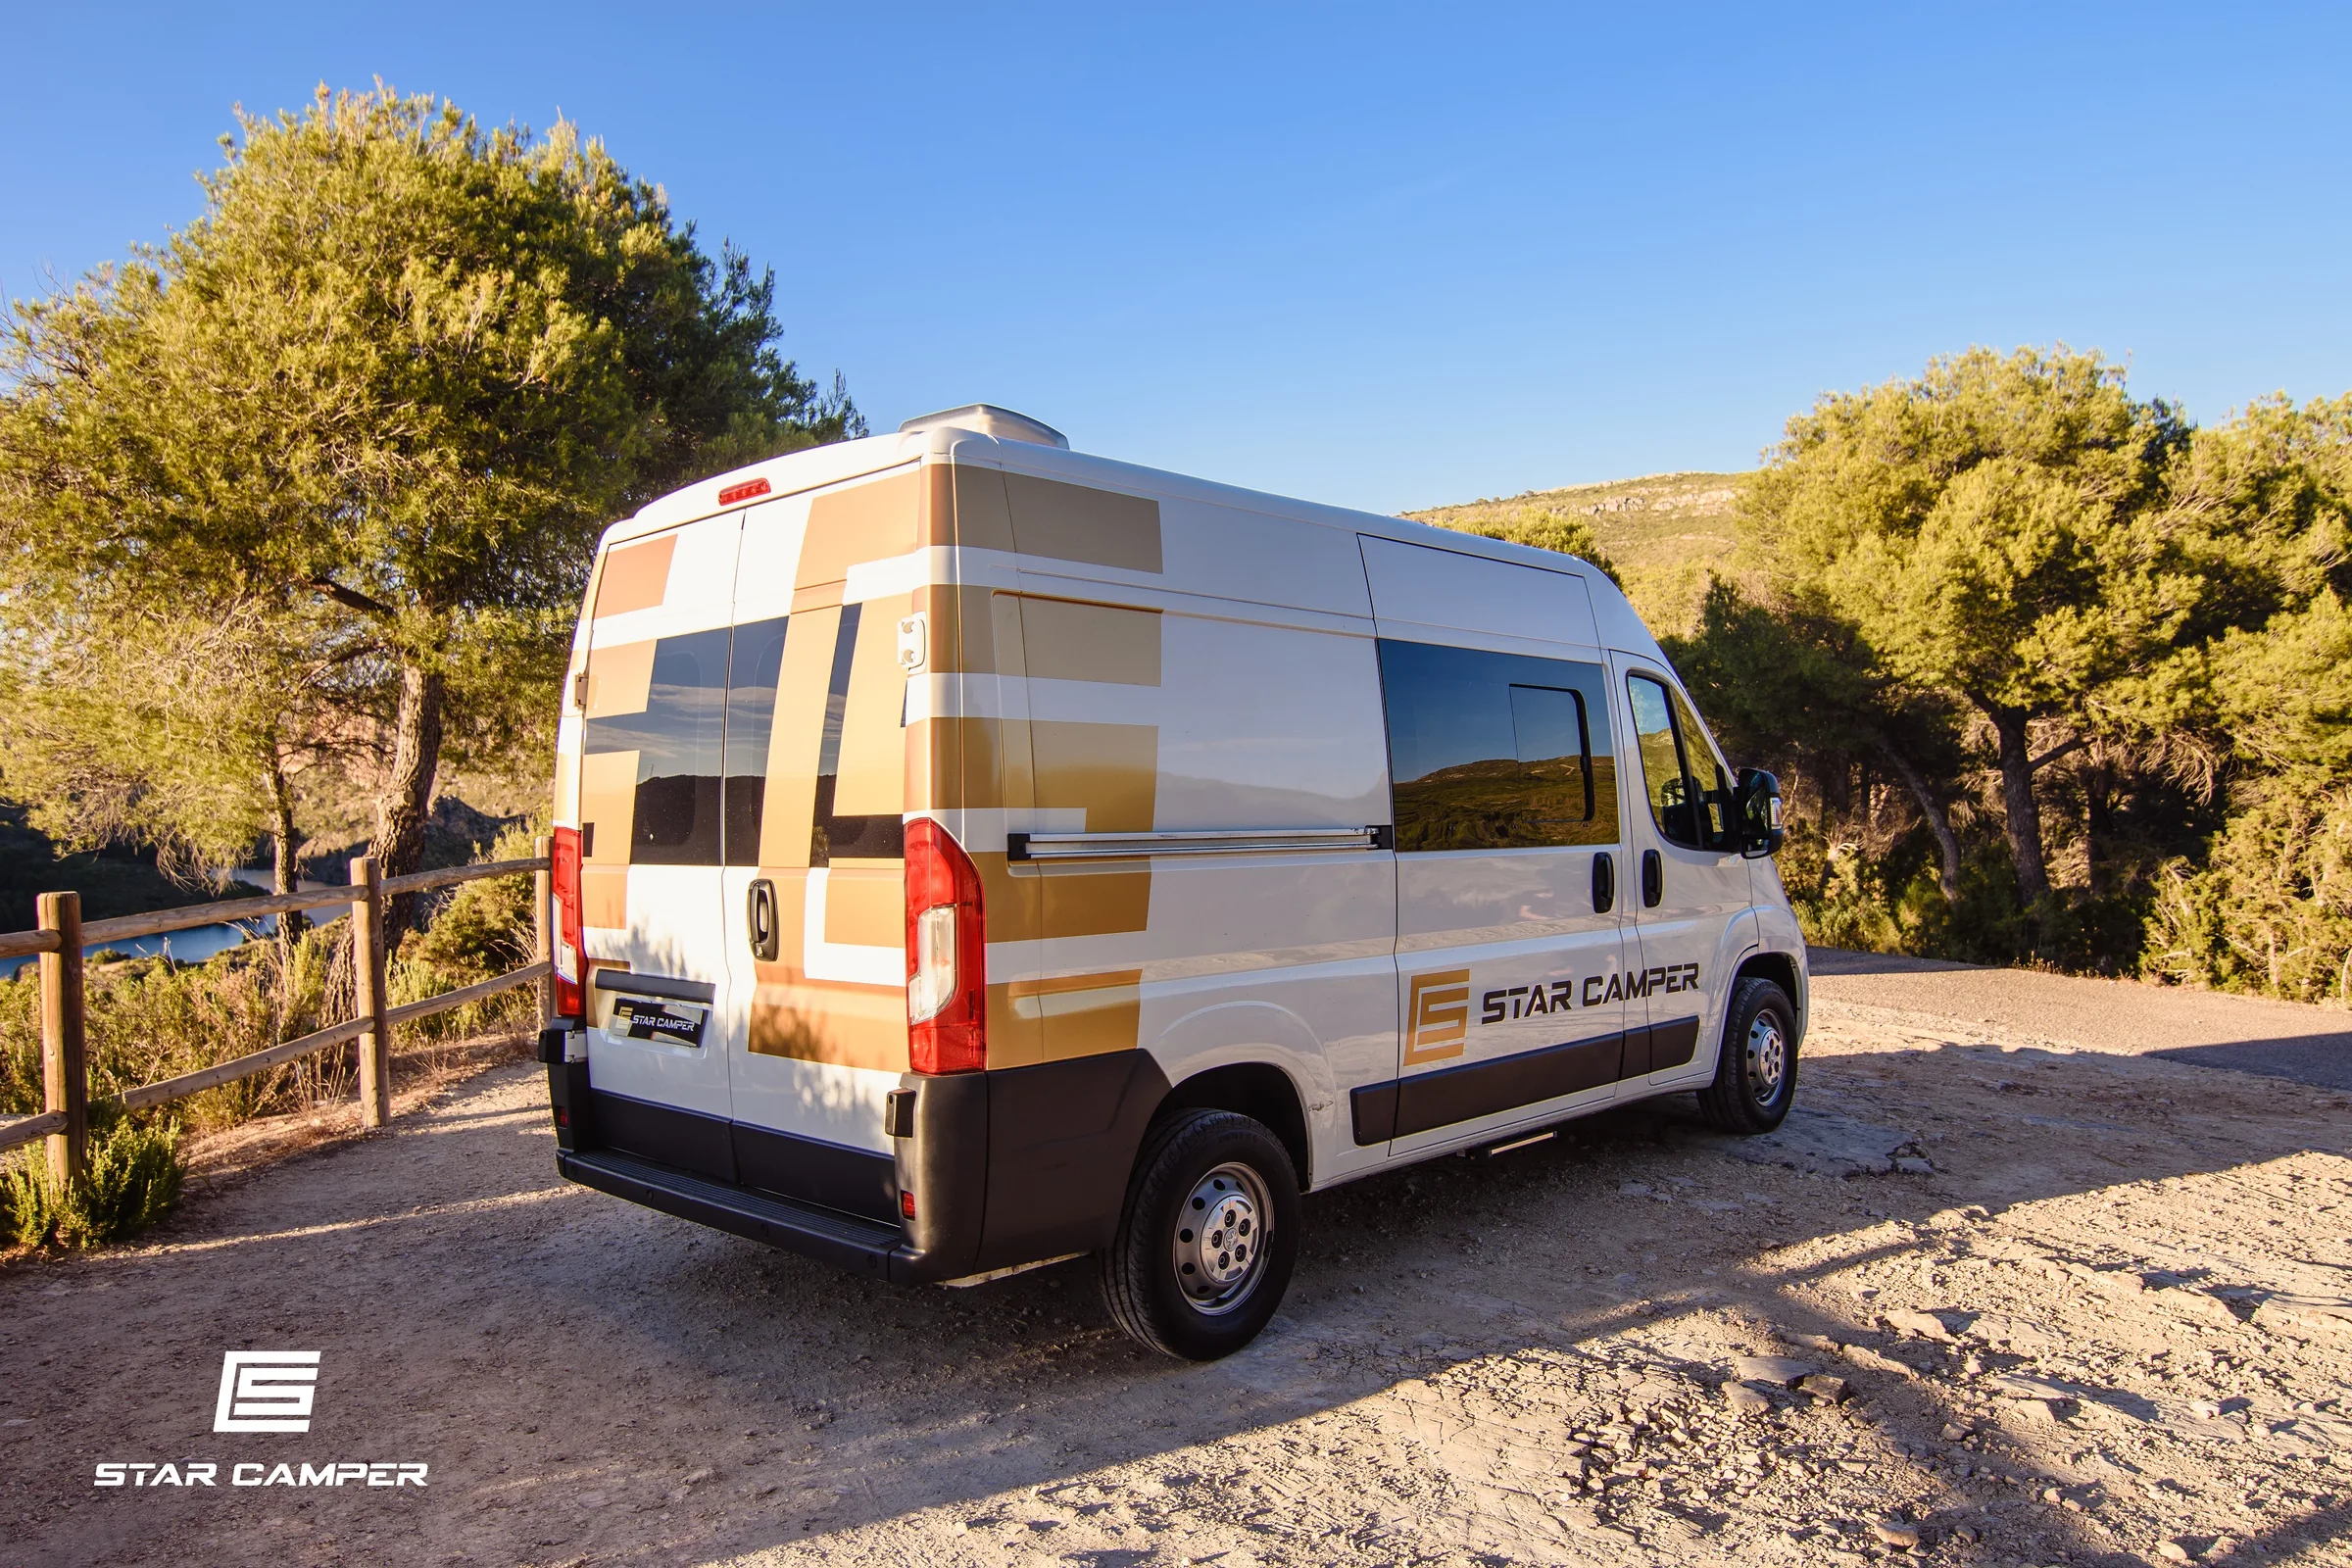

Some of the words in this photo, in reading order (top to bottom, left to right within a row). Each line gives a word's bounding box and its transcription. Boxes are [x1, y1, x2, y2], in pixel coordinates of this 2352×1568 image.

[1481, 980, 1572, 1025] STAR
[1582, 962, 1700, 1007] CAMPER
[632, 1014, 655, 1027] STAR
[657, 1017, 695, 1031] CAMPER
